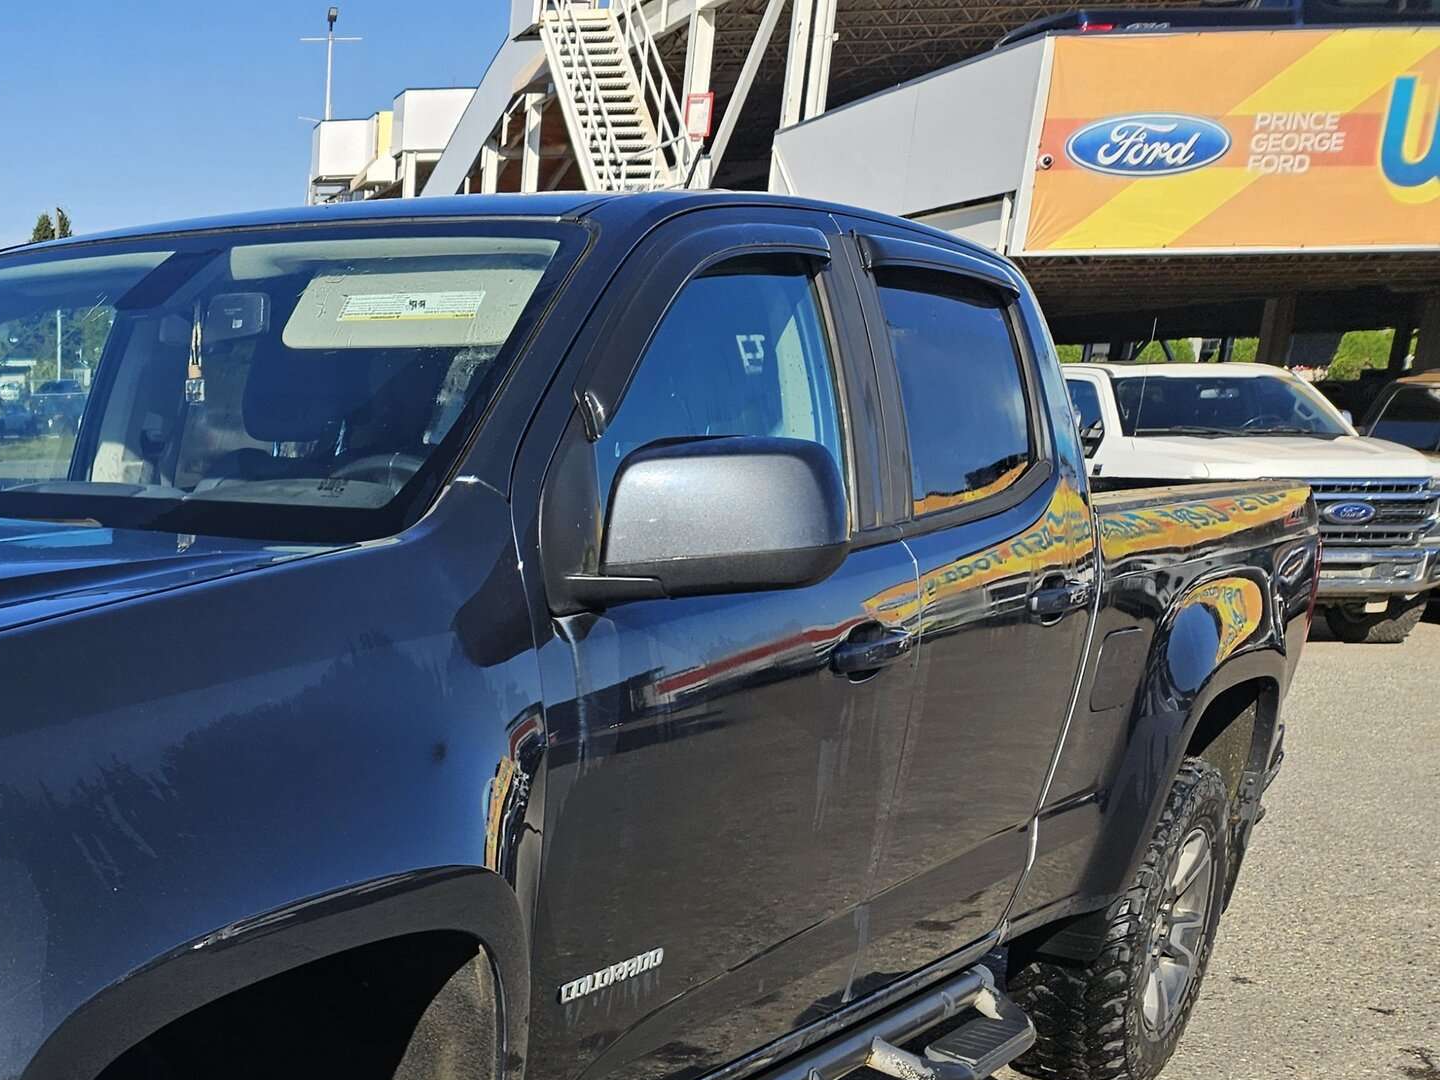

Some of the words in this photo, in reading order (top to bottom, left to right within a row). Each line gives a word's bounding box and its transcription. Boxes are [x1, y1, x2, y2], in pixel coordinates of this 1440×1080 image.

[1254, 112, 1341, 131] PRINCE
[1097, 121, 1202, 166] Ford
[1250, 132, 1345, 152] GEORGE
[1247, 154, 1311, 174] FORD
[560, 946, 664, 1005] COLORADO
